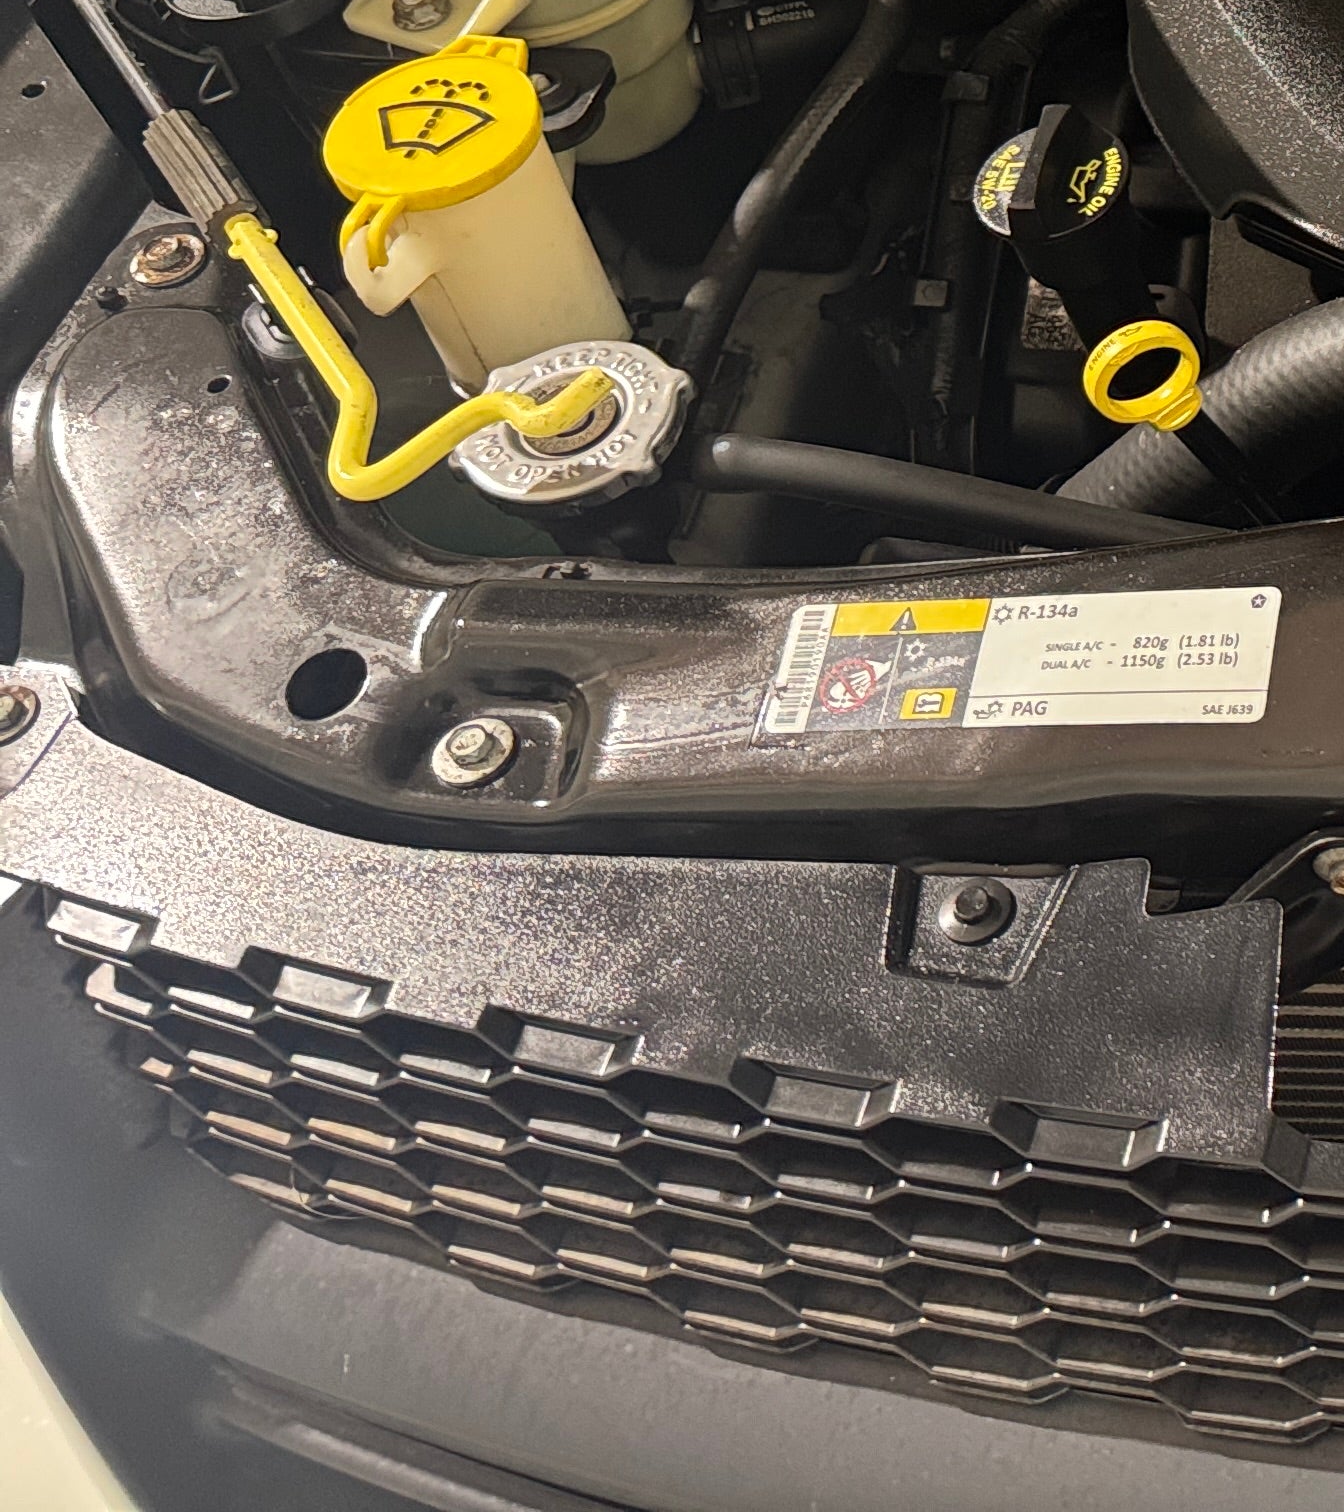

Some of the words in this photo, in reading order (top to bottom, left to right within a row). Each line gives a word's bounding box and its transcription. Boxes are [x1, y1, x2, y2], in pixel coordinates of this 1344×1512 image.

[992, 144, 1021, 169] SAE
[1099, 147, 1122, 195] ENGINE
[980, 170, 997, 210] 5W-20
[1078, 196, 1107, 216] OIL
[532, 347, 611, 377] KEEP
[1088, 338, 1116, 371] ENGINE
[475, 433, 512, 471] NOT
[507, 460, 582, 485] OPEN
[585, 430, 637, 467] HOT
[1018, 604, 1078, 619] R-134a
[1045, 641, 1081, 652] SINGLE
[1083, 640, 1104, 651] A/C
[1133, 636, 1168, 651] 820g
[1179, 635, 1215, 650] (1.81
[1220, 633, 1240, 649] lb)
[1041, 660, 1068, 670] DUAL
[1070, 658, 1091, 670] A/C
[1120, 655, 1166, 670] 1150g
[1177, 652, 1214, 669] (2.53
[1218, 652, 1239, 667] lb)
[1011, 701, 1048, 716] PAG
[1202, 705, 1224, 715] SAE
[1226, 705, 1253, 715] J639
